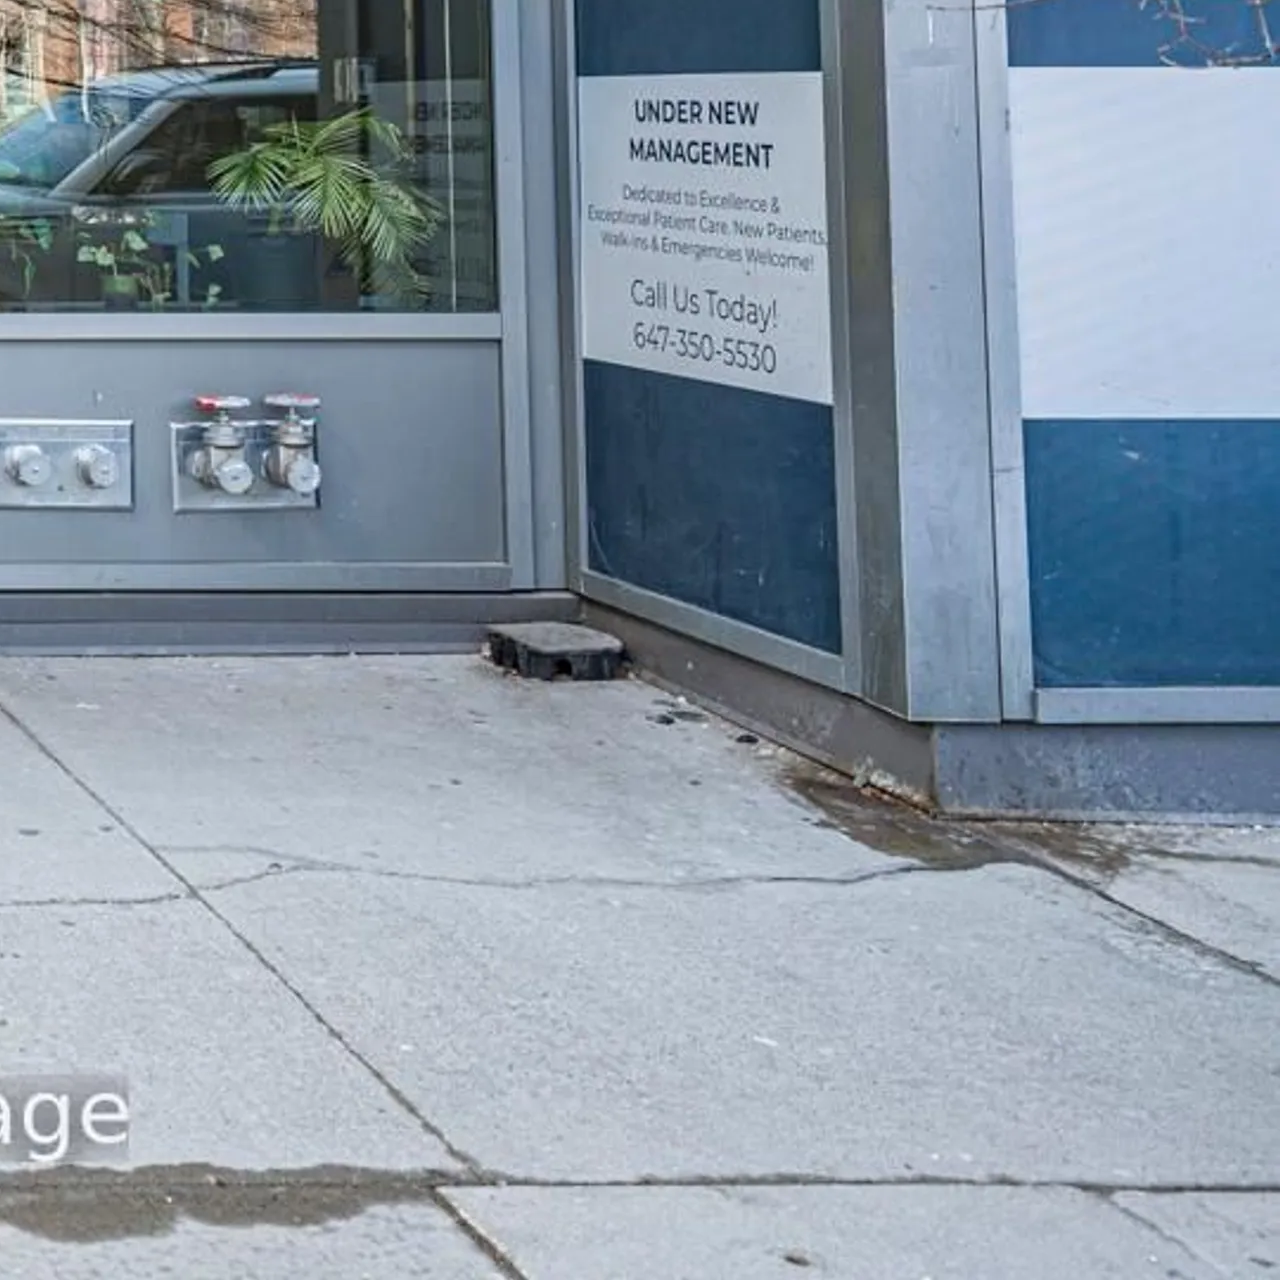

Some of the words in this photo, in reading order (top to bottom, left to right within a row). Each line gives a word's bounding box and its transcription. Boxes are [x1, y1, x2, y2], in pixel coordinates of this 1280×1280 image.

[635, 99, 702, 124] UNDER
[708, 101, 760, 126] NEW
[629, 138, 773, 169] MANAGEMENT
[622, 184, 681, 206] Dedicated
[684, 191, 697, 206] to
[699, 190, 767, 212] Excellence
[770, 196, 781, 214] &
[588, 204, 651, 226] Exceptional
[654, 211, 696, 231] Patient
[733, 221, 764, 238] New
[651, 236, 659, 253] &
[661, 237, 742, 262] Emergencies
[745, 247, 815, 271] Welcome!
[630, 279, 668, 310] Call
[673, 284, 700, 315] Us
[705, 289, 778, 333] Today!
[633, 322, 777, 374] 647-350-5530
